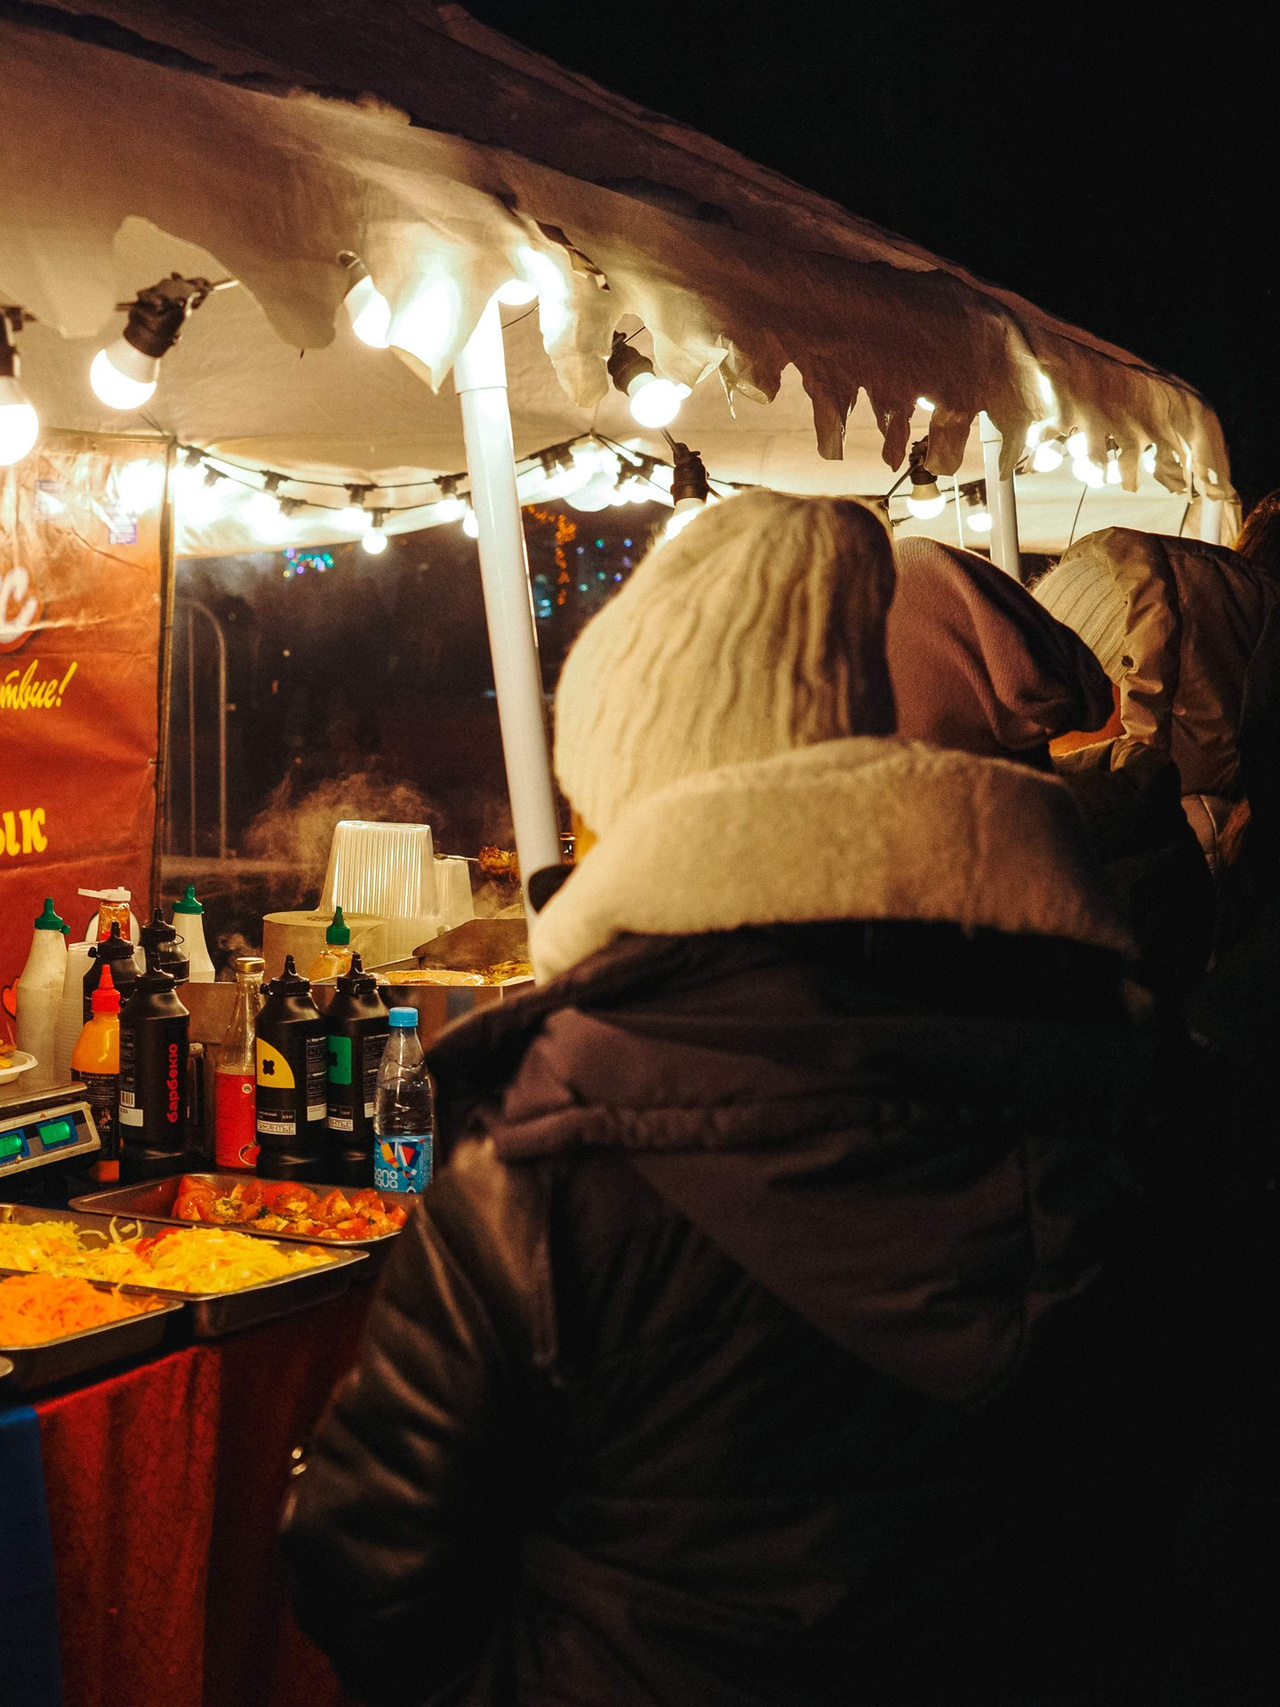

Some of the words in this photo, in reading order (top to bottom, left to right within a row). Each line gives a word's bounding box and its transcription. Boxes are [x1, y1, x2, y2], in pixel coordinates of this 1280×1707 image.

[166, 1042, 180, 1123] барбекю
[375, 1167, 398, 1179] ona
[375, 1177, 398, 1189] qua
